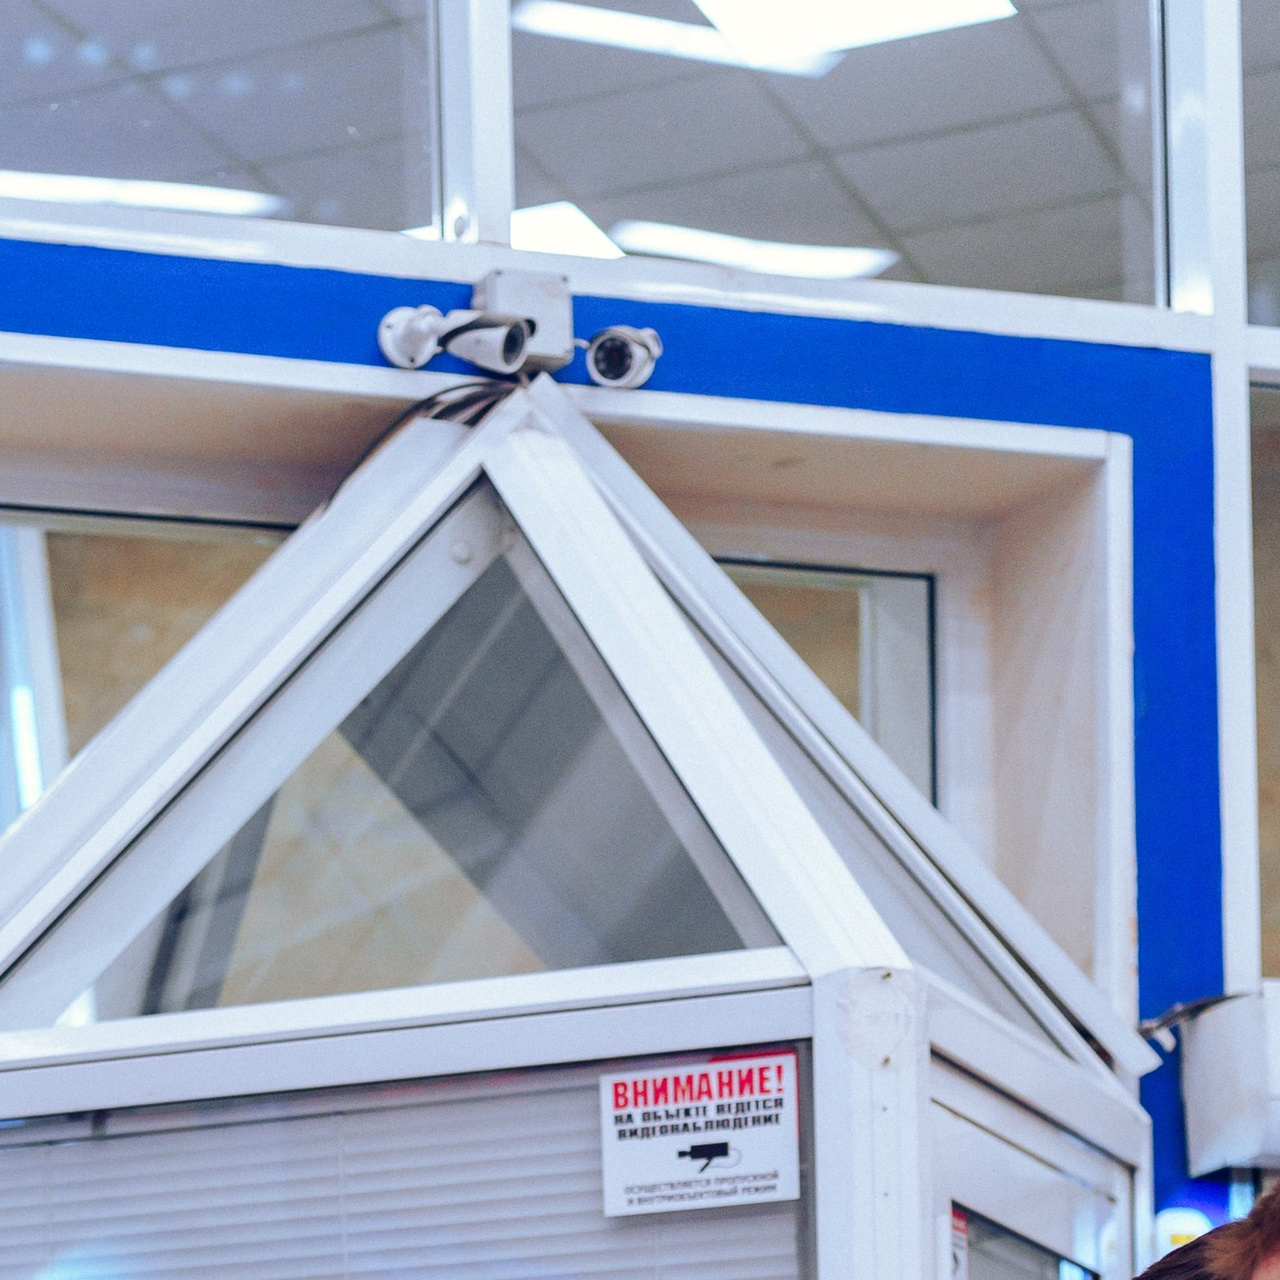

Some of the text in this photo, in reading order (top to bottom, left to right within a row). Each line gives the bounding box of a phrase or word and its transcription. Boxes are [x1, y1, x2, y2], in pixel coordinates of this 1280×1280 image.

[613, 1065, 783, 1110] ВНИМАНИЕ!
[614, 1112, 634, 1125] НА
[642, 1106, 707, 1122] ОБЪЕКТЕ
[618, 1113, 781, 1140] ВИДЕОНАБЛЮДЕНИЕ
